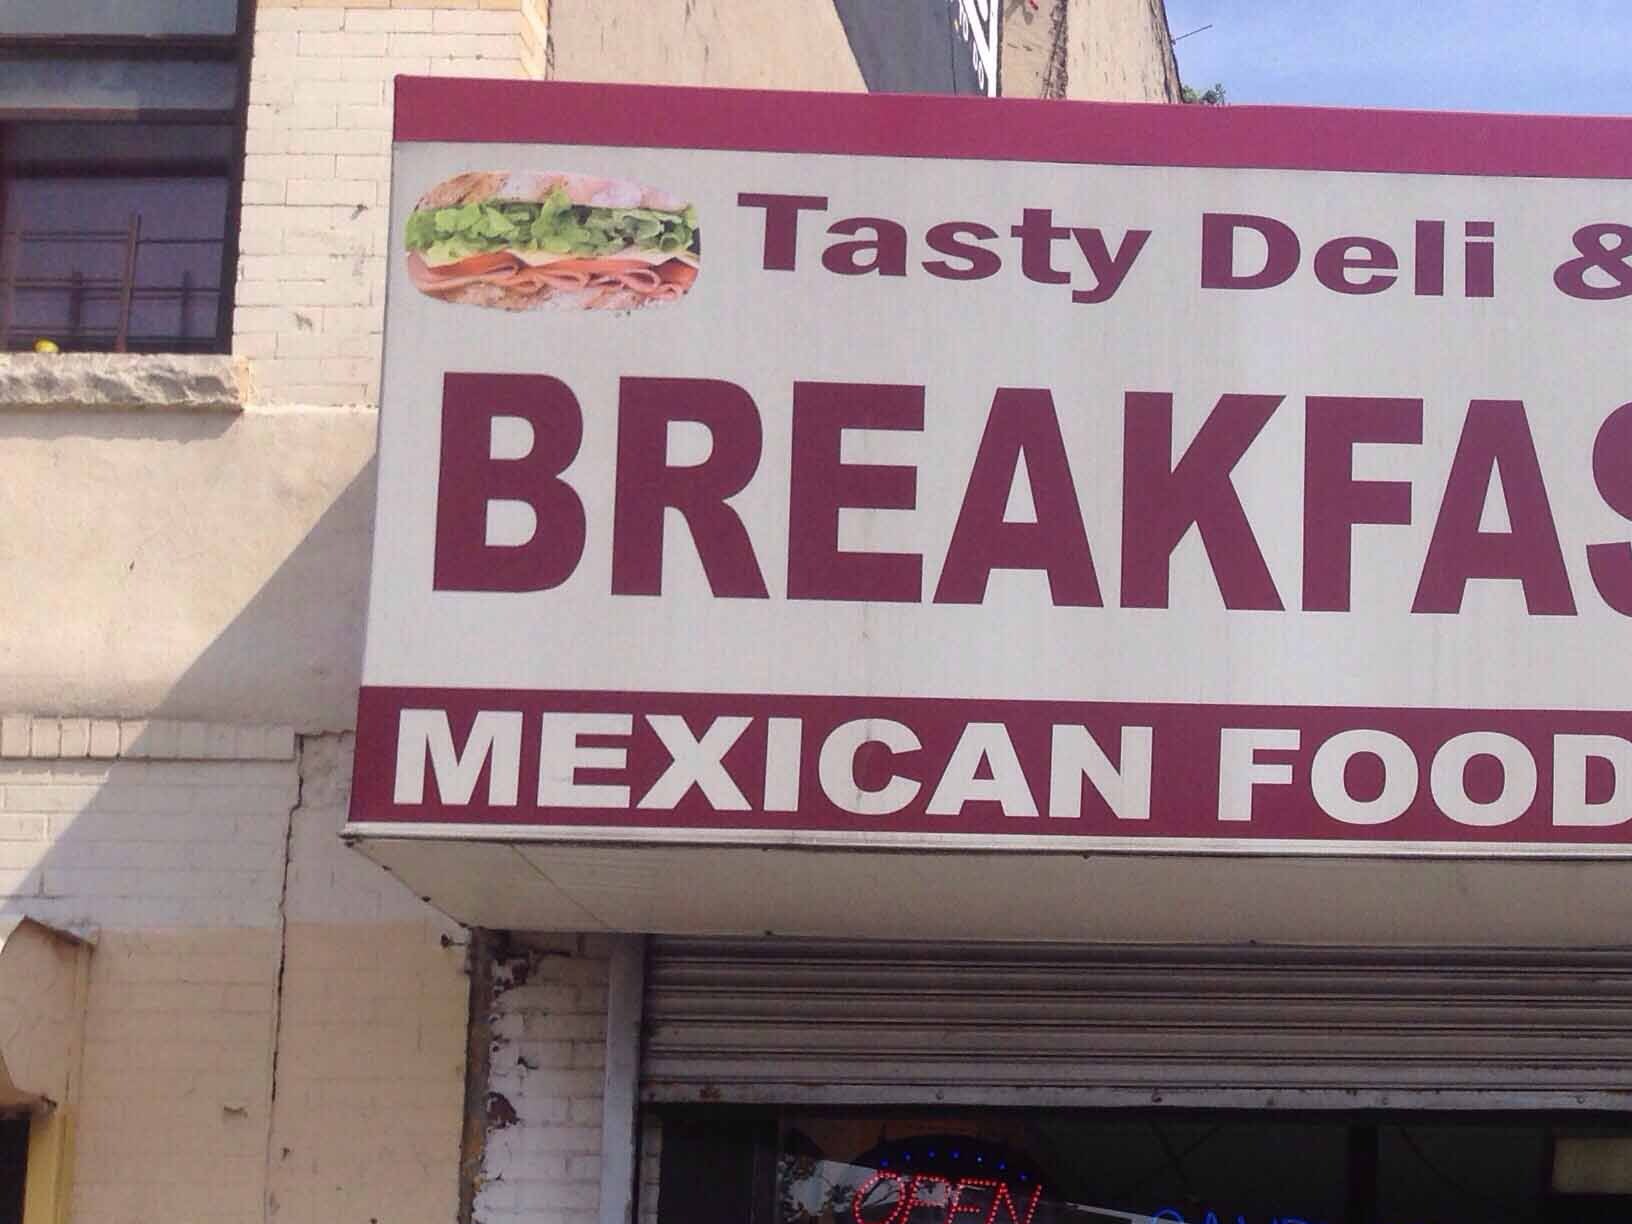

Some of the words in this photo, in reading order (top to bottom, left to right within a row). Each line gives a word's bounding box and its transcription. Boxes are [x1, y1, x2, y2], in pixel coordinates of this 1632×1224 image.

[737, 192, 1151, 303] Tasty
[1200, 212, 1494, 298] Deli
[393, 708, 1153, 822] MEXICAN
